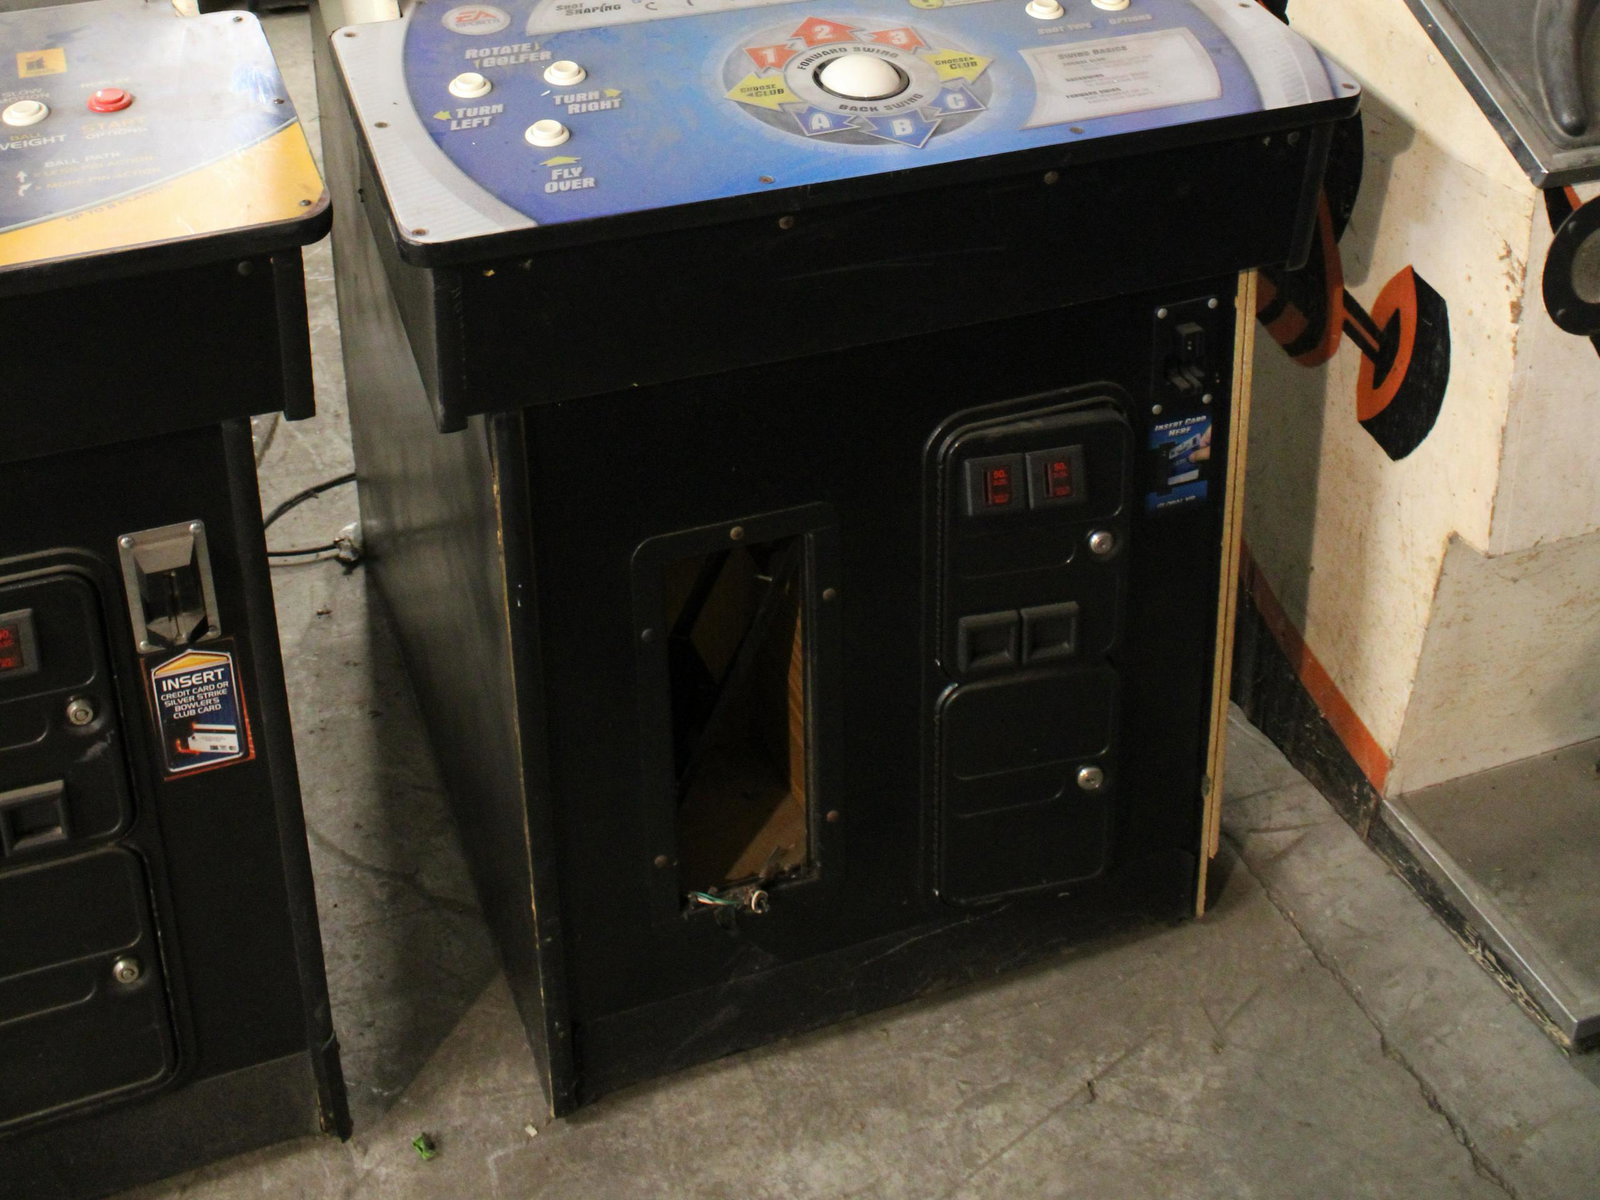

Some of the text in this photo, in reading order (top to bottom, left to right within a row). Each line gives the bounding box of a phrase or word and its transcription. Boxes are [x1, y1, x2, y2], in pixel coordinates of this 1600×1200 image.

[455, 10, 497, 23] EA
[564, 3, 622, 17] SHAPING
[814, 24, 834, 40] 2
[890, 29, 909, 45] 3
[464, 42, 533, 60] ROTATE
[481, 50, 552, 68] GOLFER
[759, 48, 778, 64] 1
[796, 46, 900, 71] FORWARD SWING
[934, 56, 970, 67] CHOOSE
[949, 60, 979, 71] CLUB
[739, 83, 776, 94] CHOOSE
[754, 87, 785, 98] CLUB
[553, 90, 600, 106] TURN
[838, 93, 924, 113] BACK SWING
[945, 93, 967, 109] C
[455, 103, 504, 119] TURN
[567, 98, 622, 115] RIGHT
[450, 116, 492, 131] LEFT
[811, 112, 832, 131] A
[892, 118, 914, 137] B
[10, 133, 41, 142] BALL
[44, 151, 121, 168] BALL PATH
[551, 166, 583, 181] FLY
[544, 176, 596, 194] OVER
[1155, 415, 1207, 432] INSERT CARD
[162, 667, 225, 692] INSERT
[160, 680, 229, 701] CREDIT CARD OR
[164, 688, 228, 708] SILVER STRIKE
[173, 703, 222, 720] CLUB CARD
